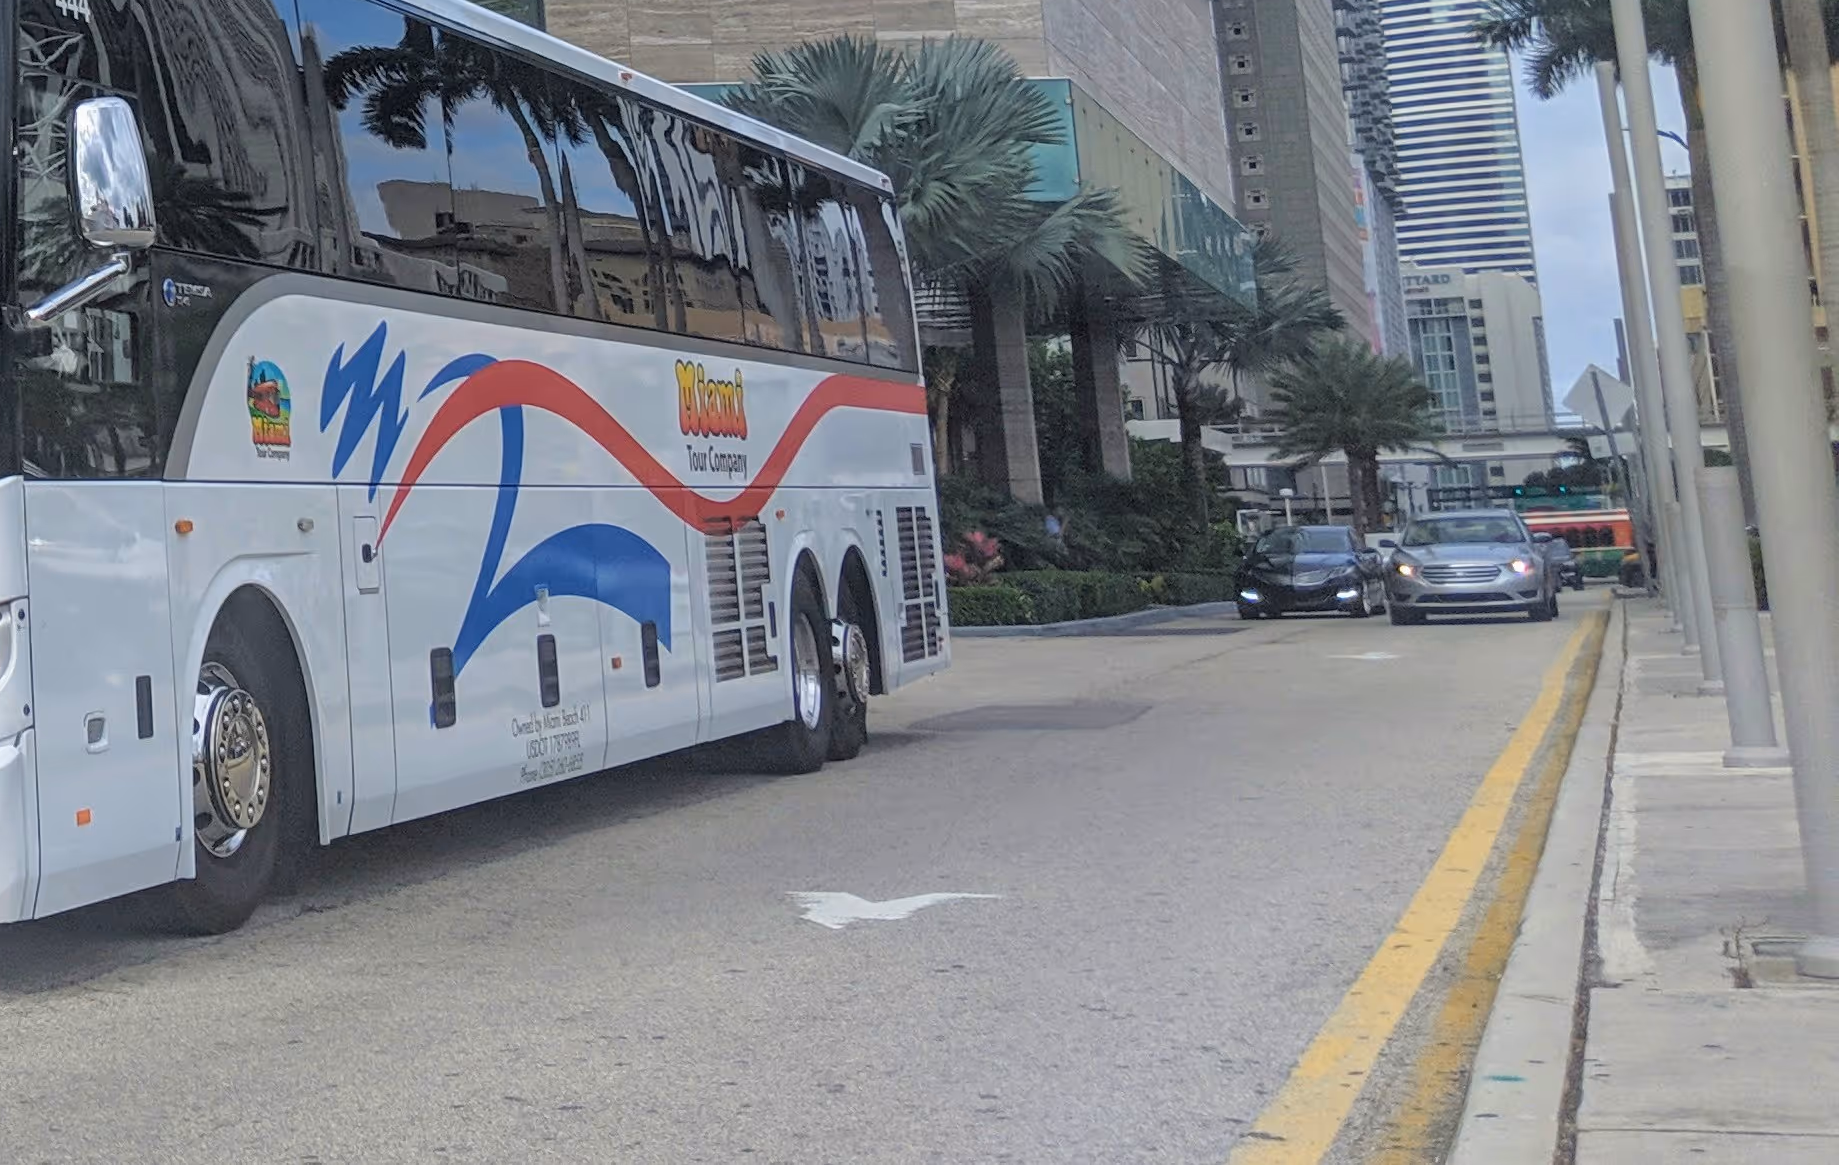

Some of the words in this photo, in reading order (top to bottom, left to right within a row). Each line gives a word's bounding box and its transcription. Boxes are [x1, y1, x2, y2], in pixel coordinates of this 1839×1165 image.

[675, 358, 748, 441] Miami
[686, 444, 707, 472] Tour
[708, 445, 748, 481] Company
